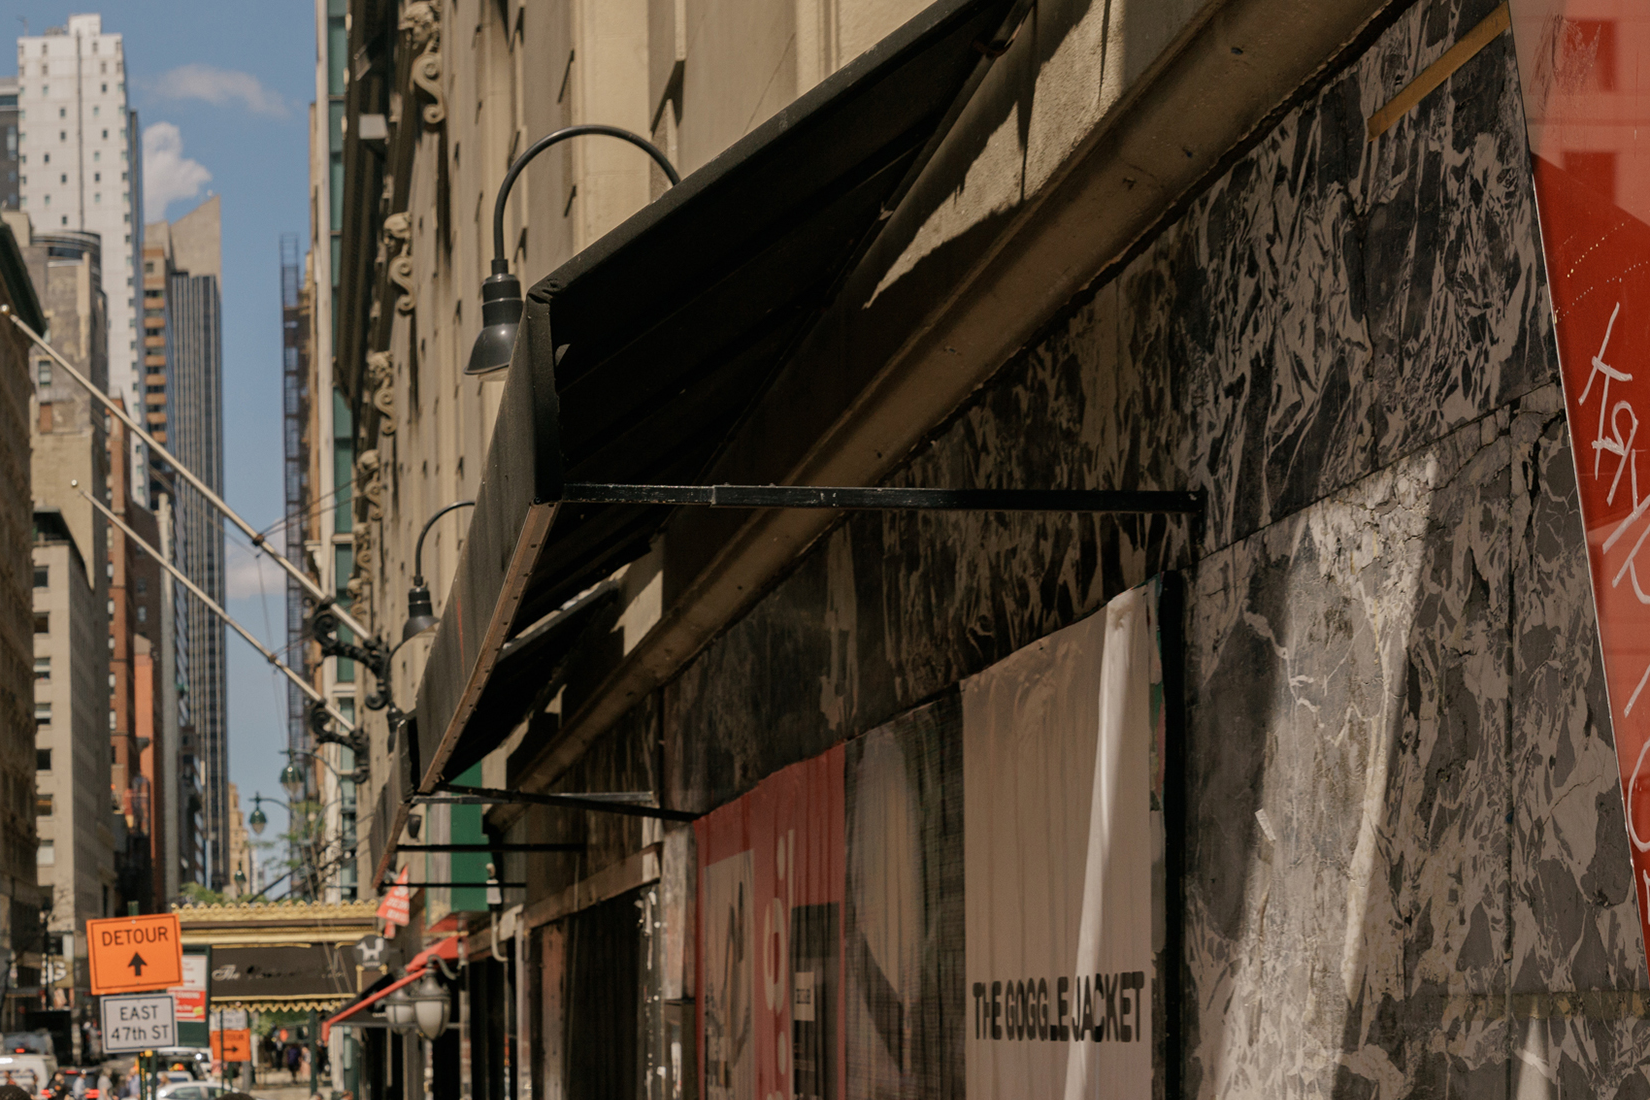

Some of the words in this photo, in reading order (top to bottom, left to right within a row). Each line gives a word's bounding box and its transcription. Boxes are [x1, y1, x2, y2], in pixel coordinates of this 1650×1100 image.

[102, 926, 168, 946] DETOUR
[120, 1005, 158, 1020] EAST
[972, 981, 1002, 1040] THE
[1005, 976, 1068, 1041] GOGGLE
[1072, 971, 1145, 1042] JACKET
[111, 1026, 147, 1041] 47th
[151, 1025, 169, 1039] ST
